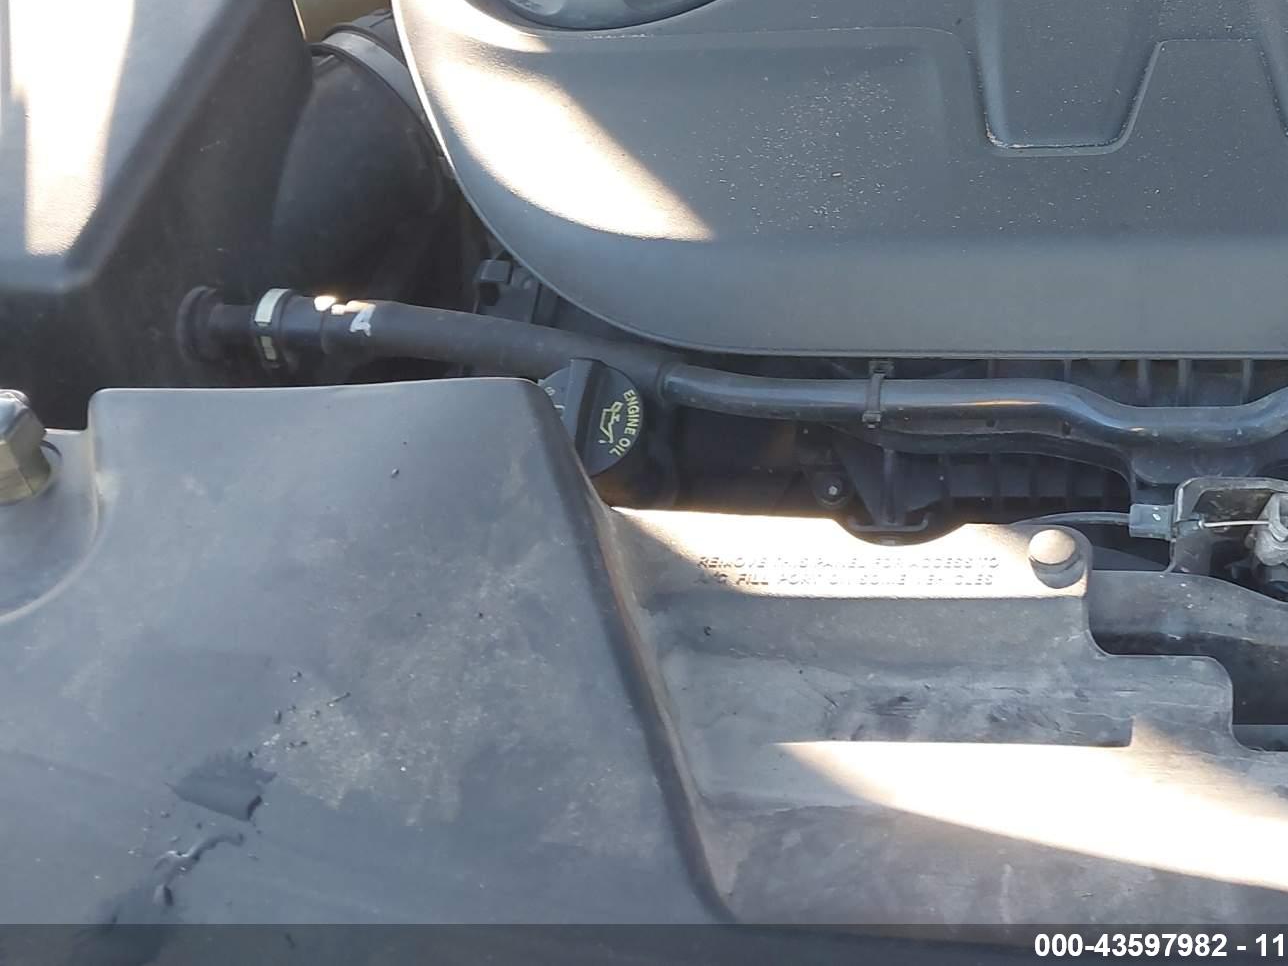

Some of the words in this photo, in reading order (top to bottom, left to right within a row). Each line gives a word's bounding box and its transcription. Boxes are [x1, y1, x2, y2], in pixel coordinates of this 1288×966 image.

[622, 388, 641, 435] ENGINE
[609, 437, 631, 457] OIL
[736, 572, 769, 585] FILL
